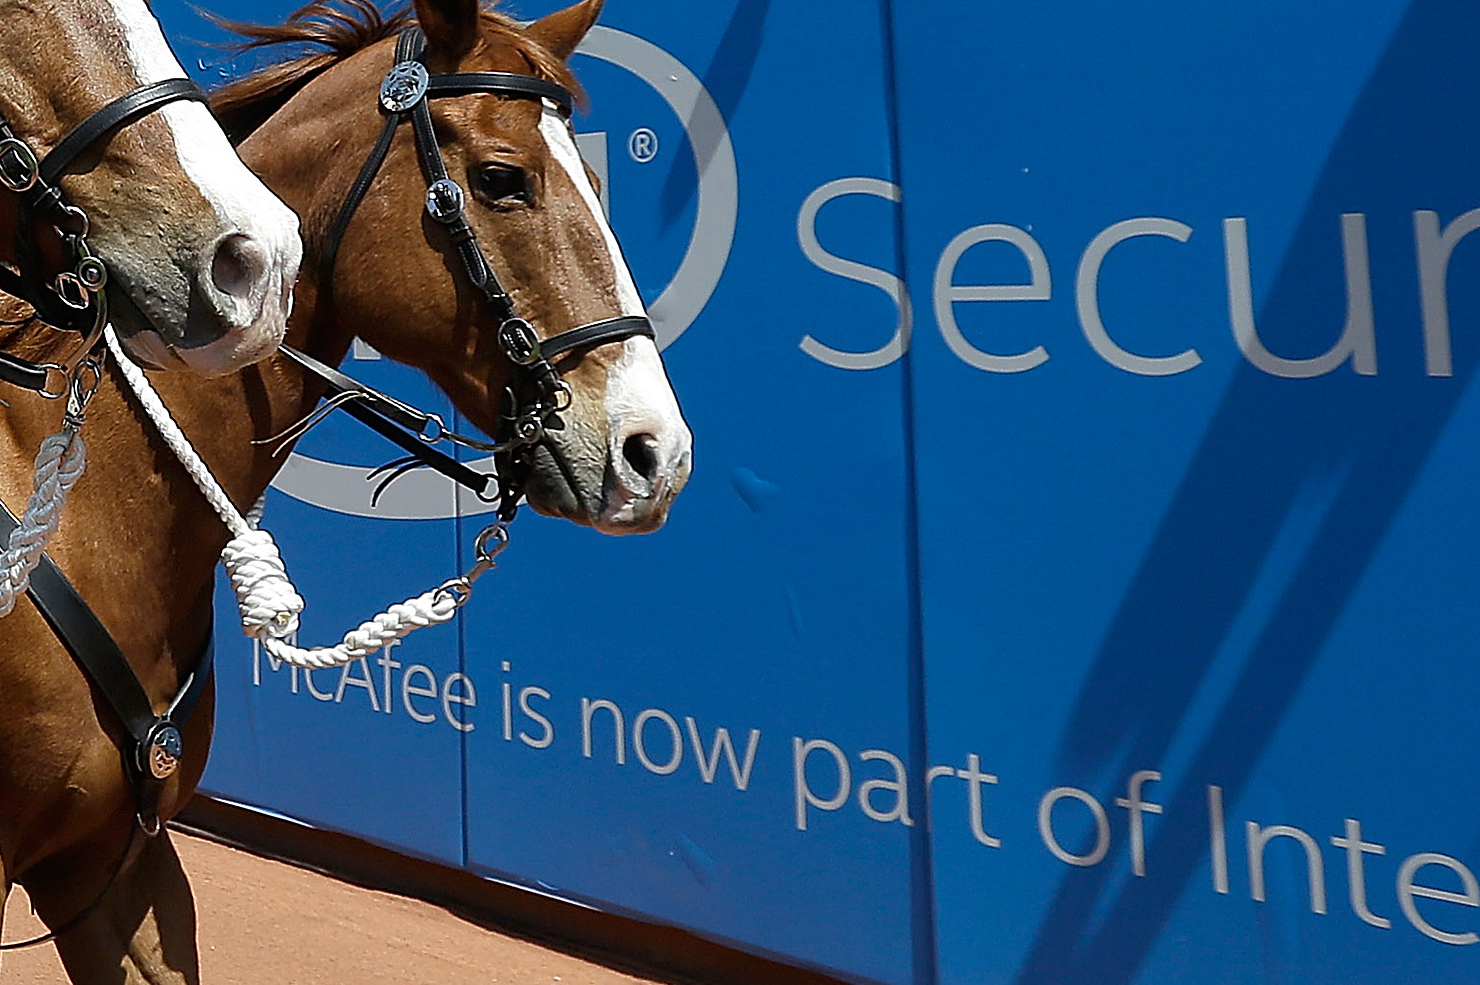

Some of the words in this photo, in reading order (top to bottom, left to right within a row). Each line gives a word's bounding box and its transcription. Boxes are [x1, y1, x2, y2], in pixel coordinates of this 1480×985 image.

[252, 629, 477, 733] McAfee
[501, 660, 555, 750] is
[580, 696, 762, 792] now
[792, 735, 1002, 849] part
[1036, 769, 1164, 878] of
[1206, 783, 1480, 946] Inte
